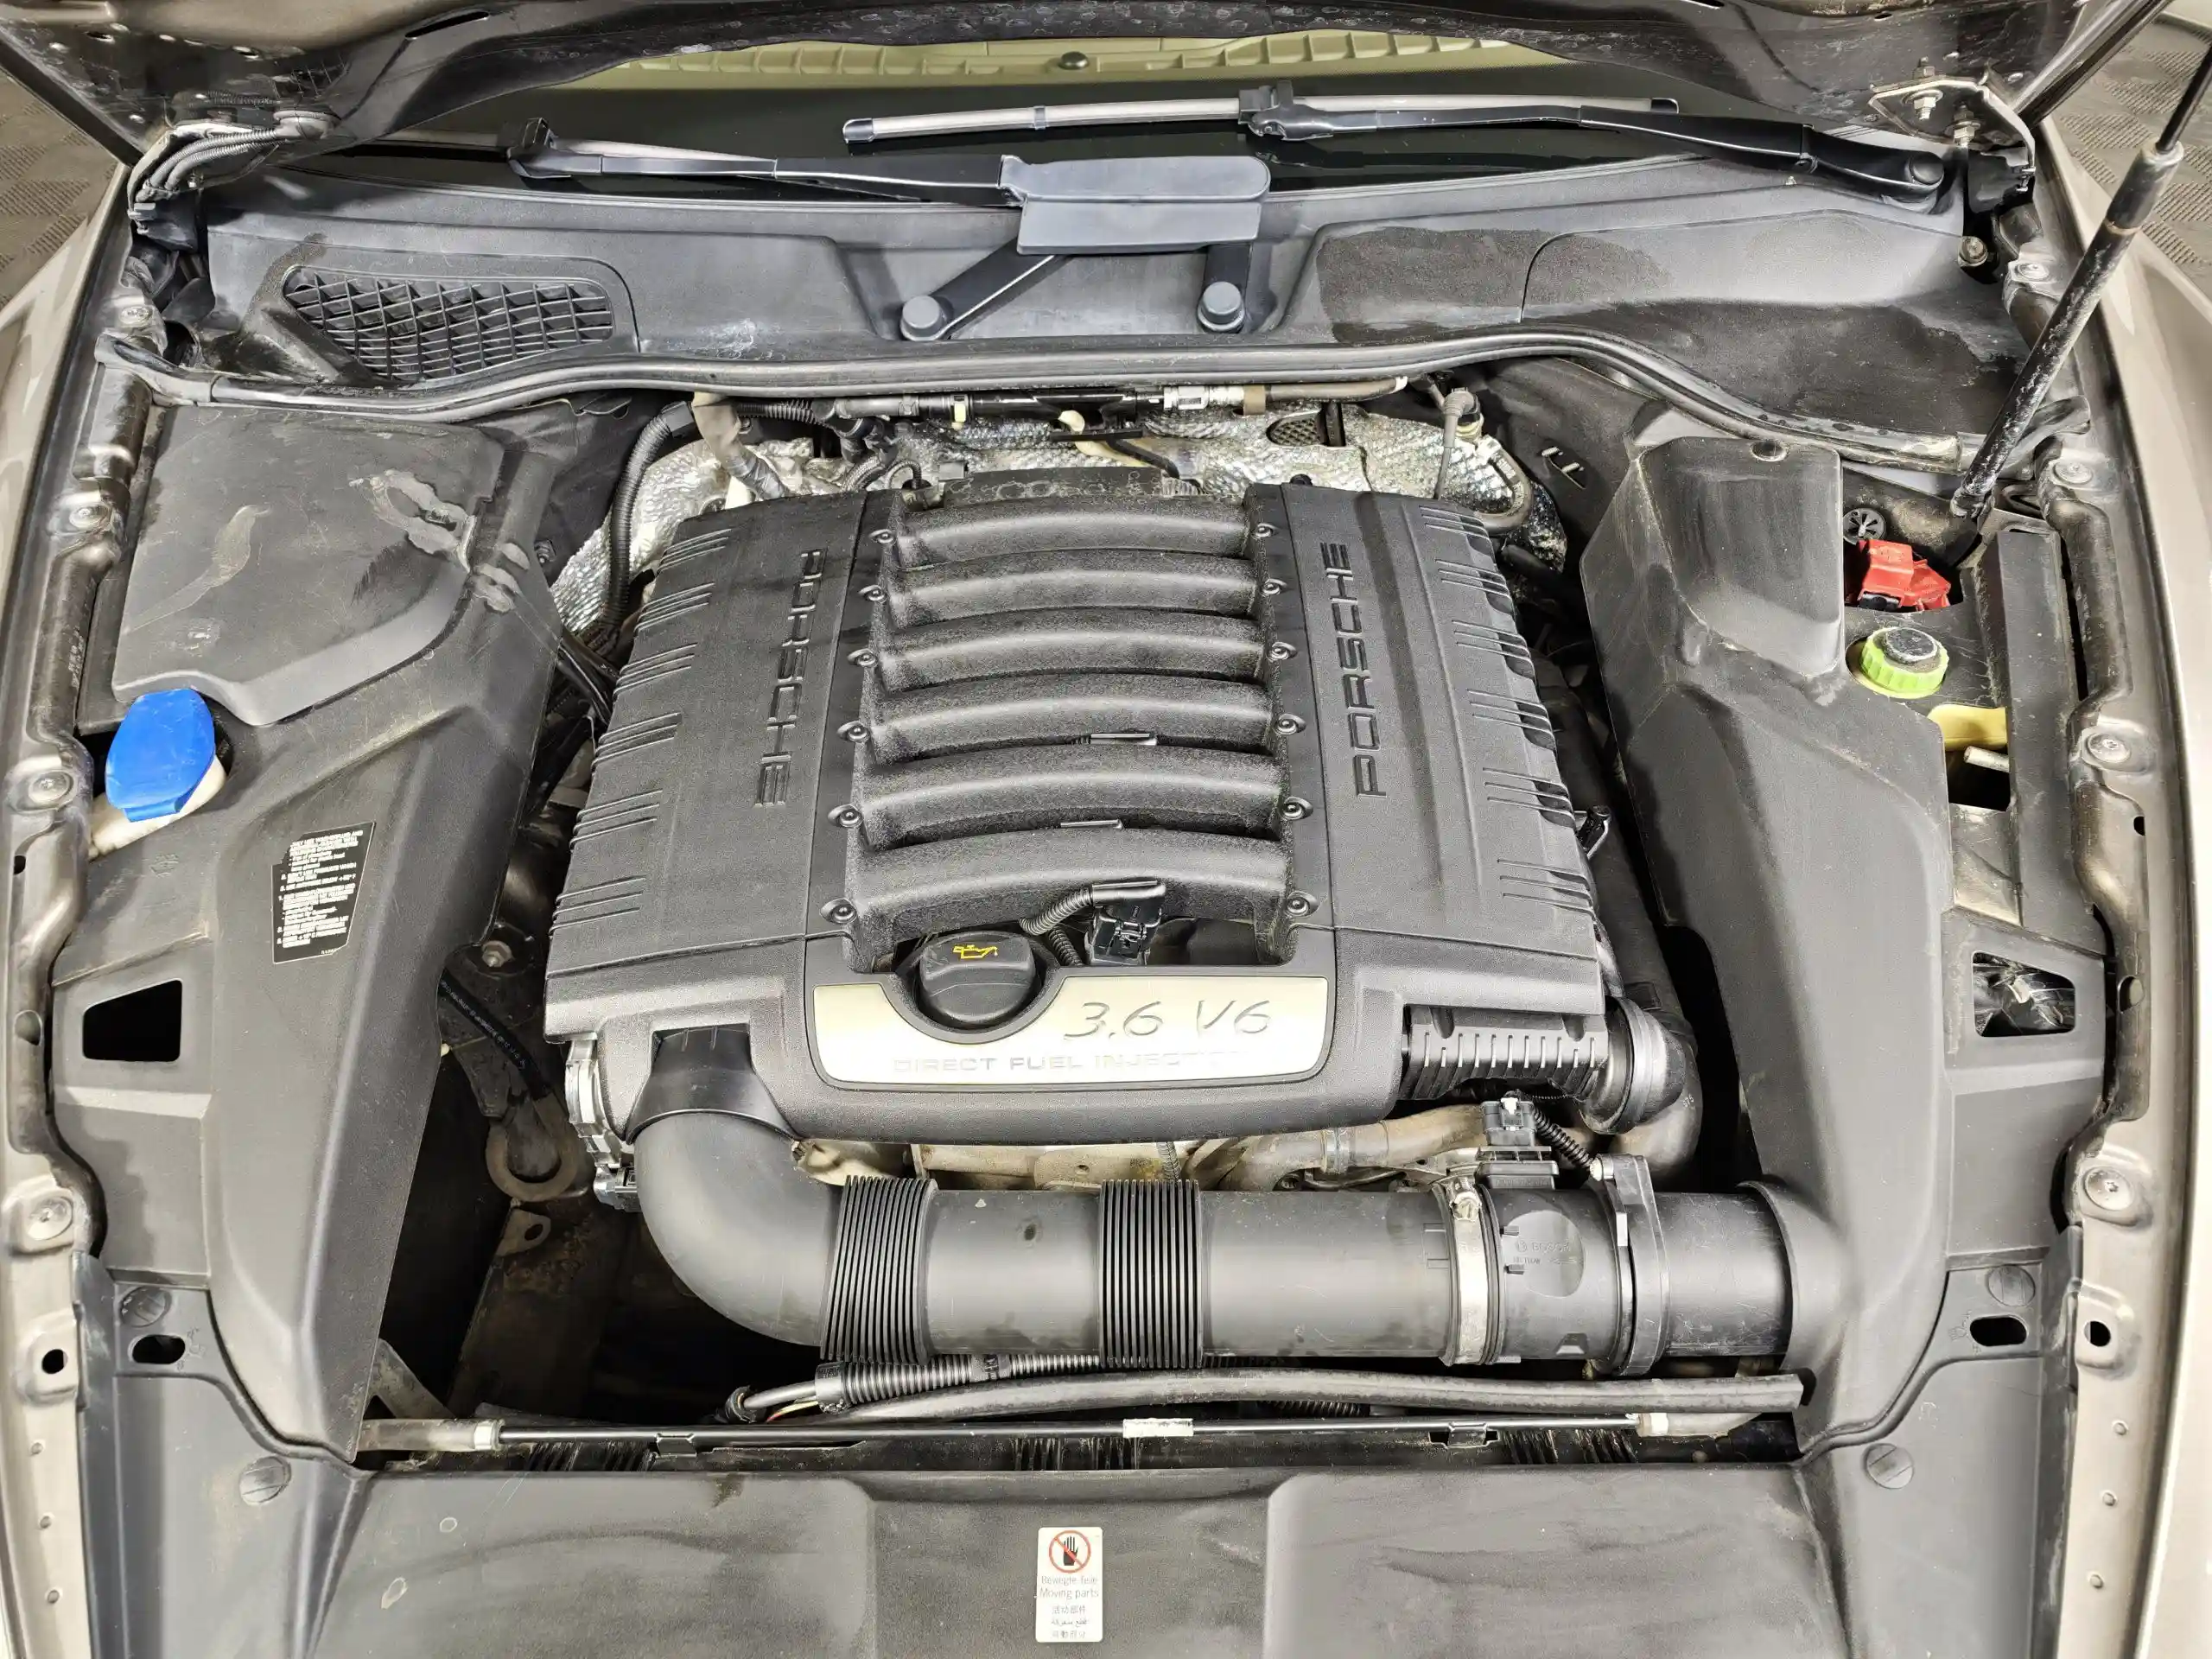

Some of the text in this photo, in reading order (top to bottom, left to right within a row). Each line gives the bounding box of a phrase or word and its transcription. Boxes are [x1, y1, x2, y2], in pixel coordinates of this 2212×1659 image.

[754, 547, 829, 809] PORSCHE
[1319, 542, 1387, 798] PORSCHE
[1064, 1000, 1271, 1040] 3.6 V6
[893, 1057, 997, 1072] DIRECT
[1009, 1055, 1084, 1071] FUEL
[1039, 1587, 1099, 1600] Moving parts
